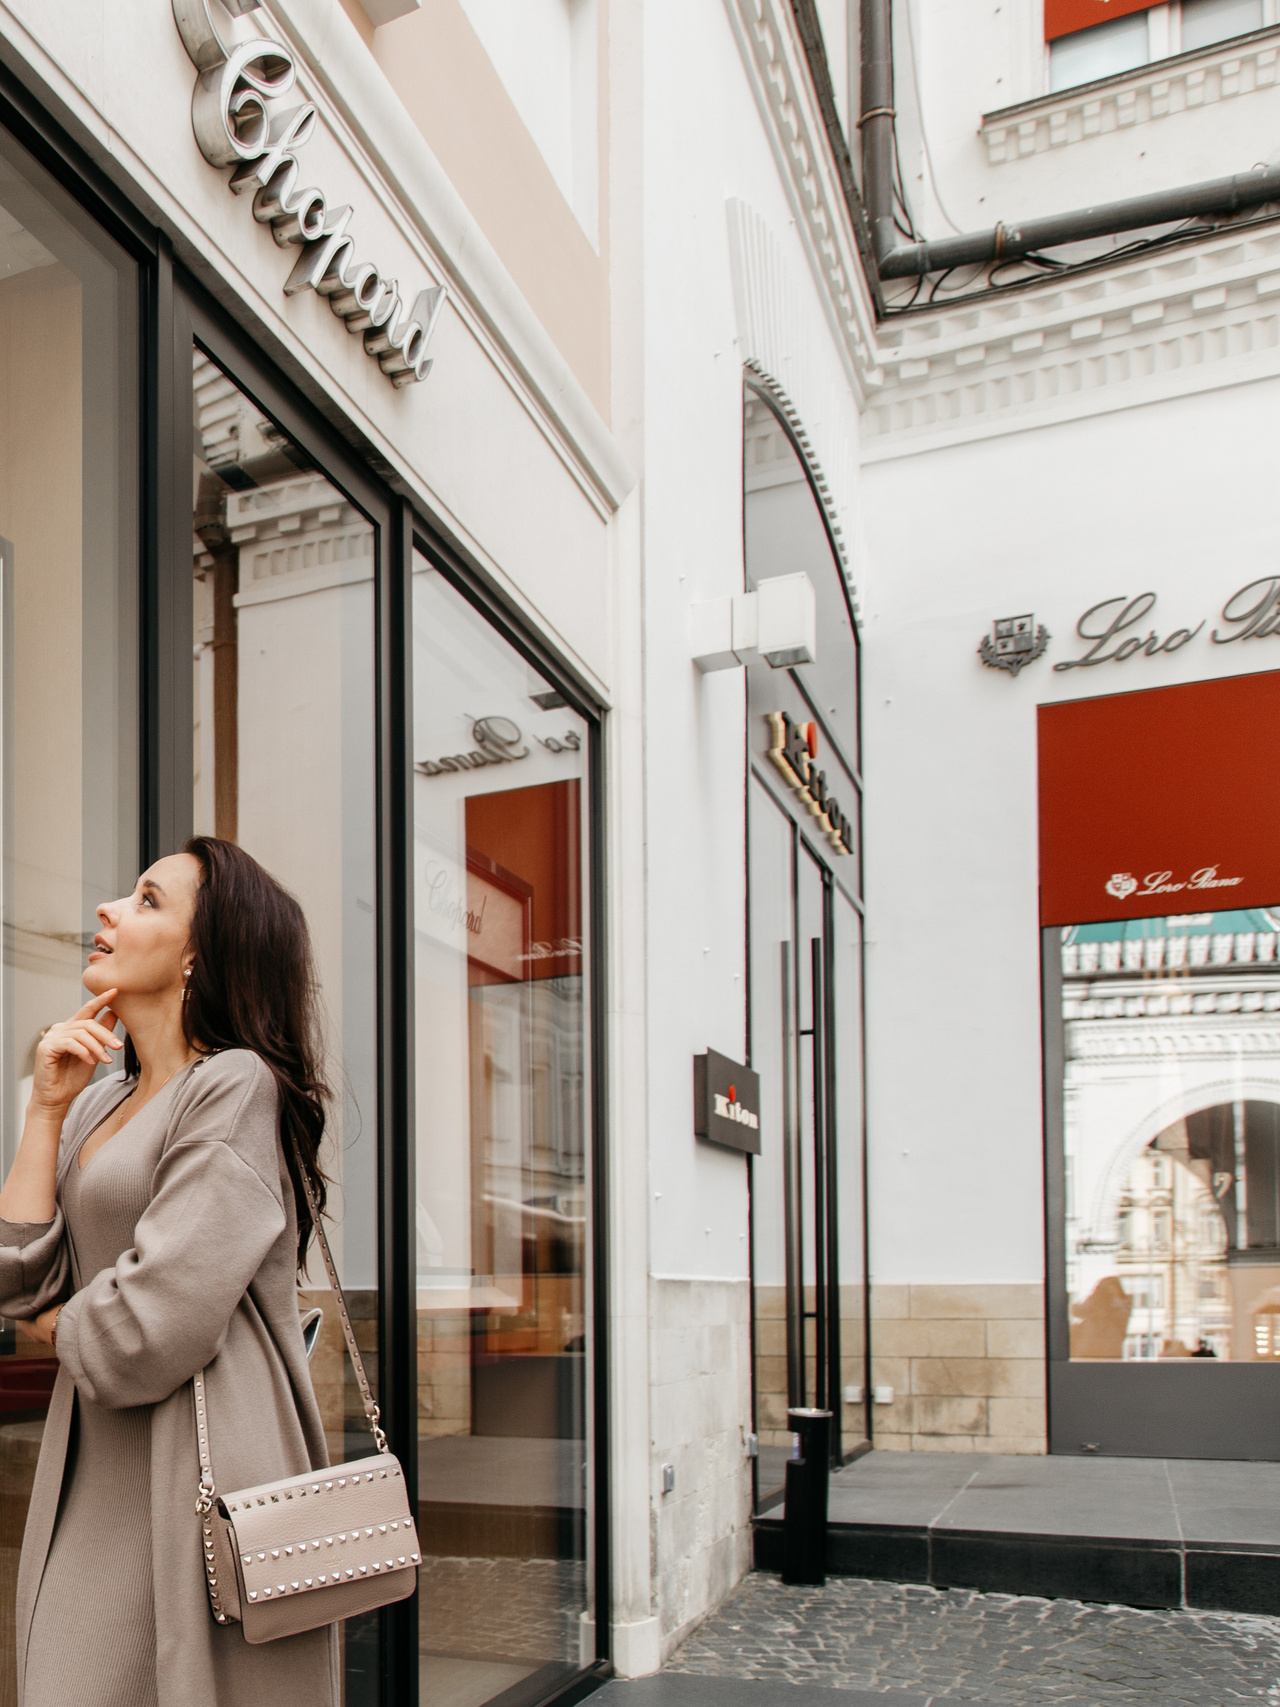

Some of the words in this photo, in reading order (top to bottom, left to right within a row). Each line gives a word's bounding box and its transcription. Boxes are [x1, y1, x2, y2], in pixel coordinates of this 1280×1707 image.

[174, 0, 449, 390] Chopard
[1052, 591, 1207, 672] Loro
[1136, 870, 1188, 896] Loro
[1187, 863, 1245, 890] Piana
[713, 1085, 760, 1130] Kiton
